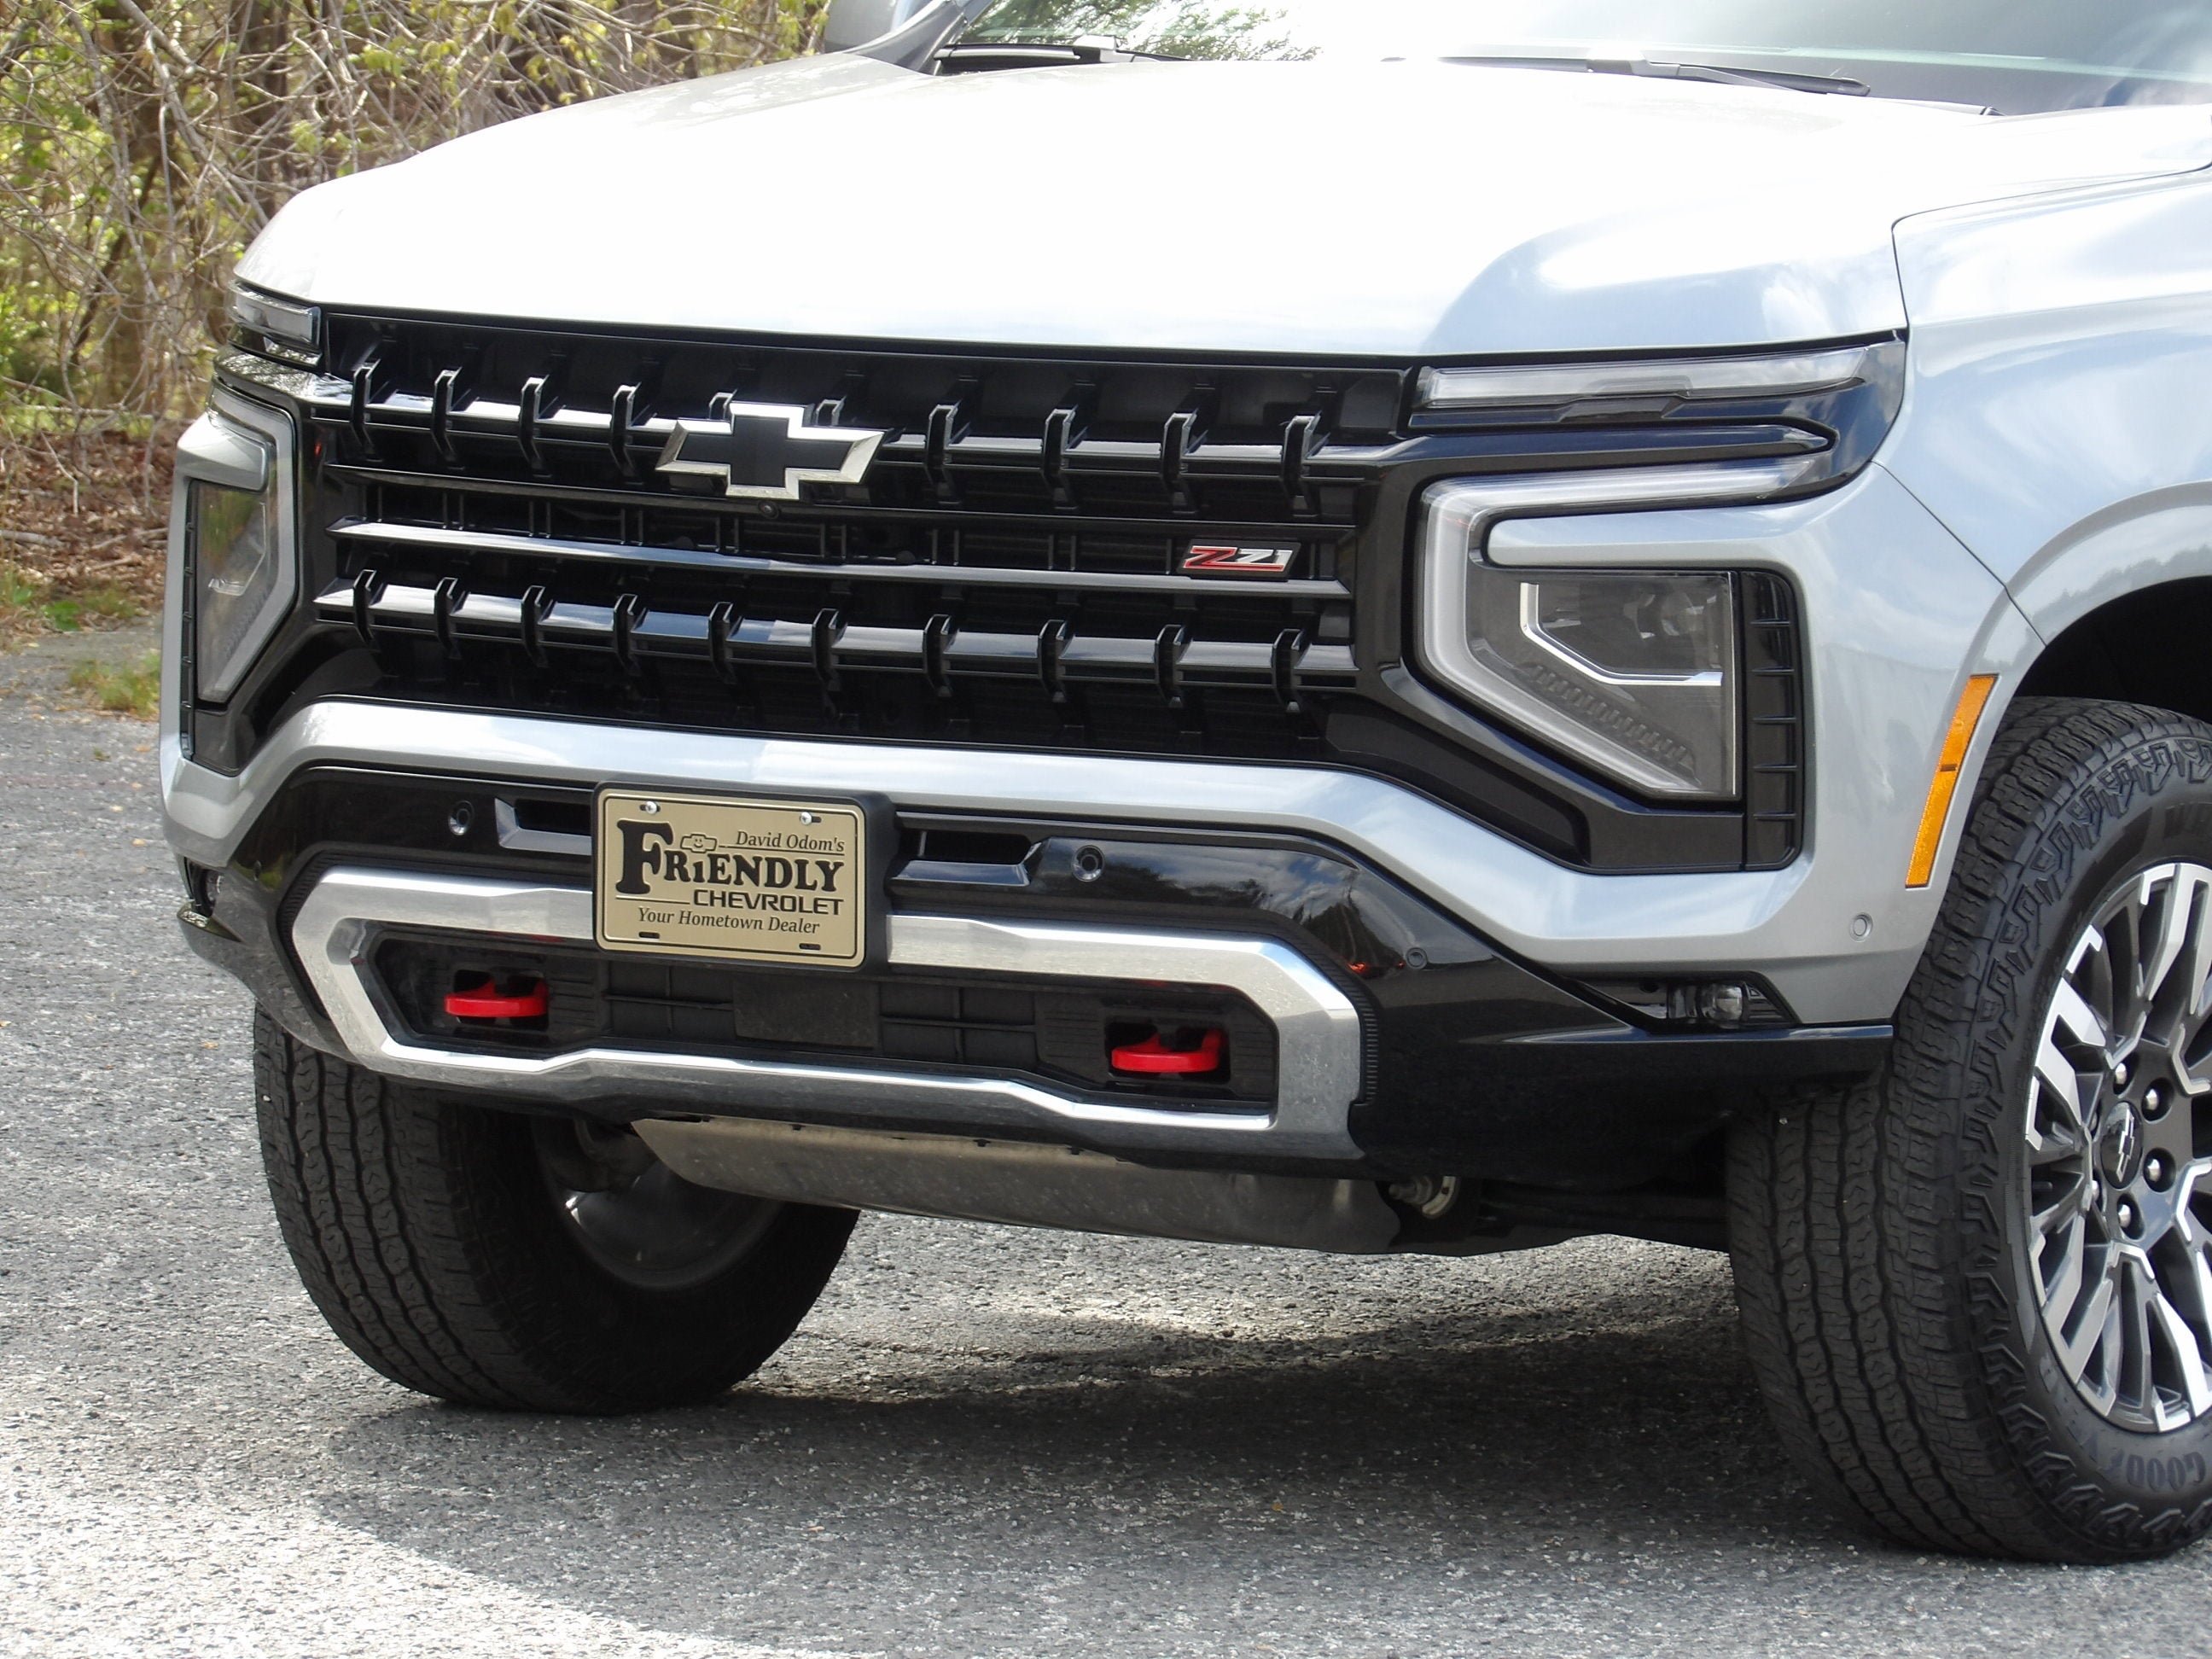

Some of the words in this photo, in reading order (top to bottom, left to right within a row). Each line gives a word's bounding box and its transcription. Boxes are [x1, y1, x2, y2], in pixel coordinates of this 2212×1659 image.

[1183, 545, 1294, 572] Z71
[736, 831, 781, 847] David
[786, 834, 845, 852] Odom's
[693, 889, 844, 915] CHEVROLET
[638, 907, 674, 924] Your
[678, 910, 763, 930] Hometown
[767, 917, 820, 934] Dealer
